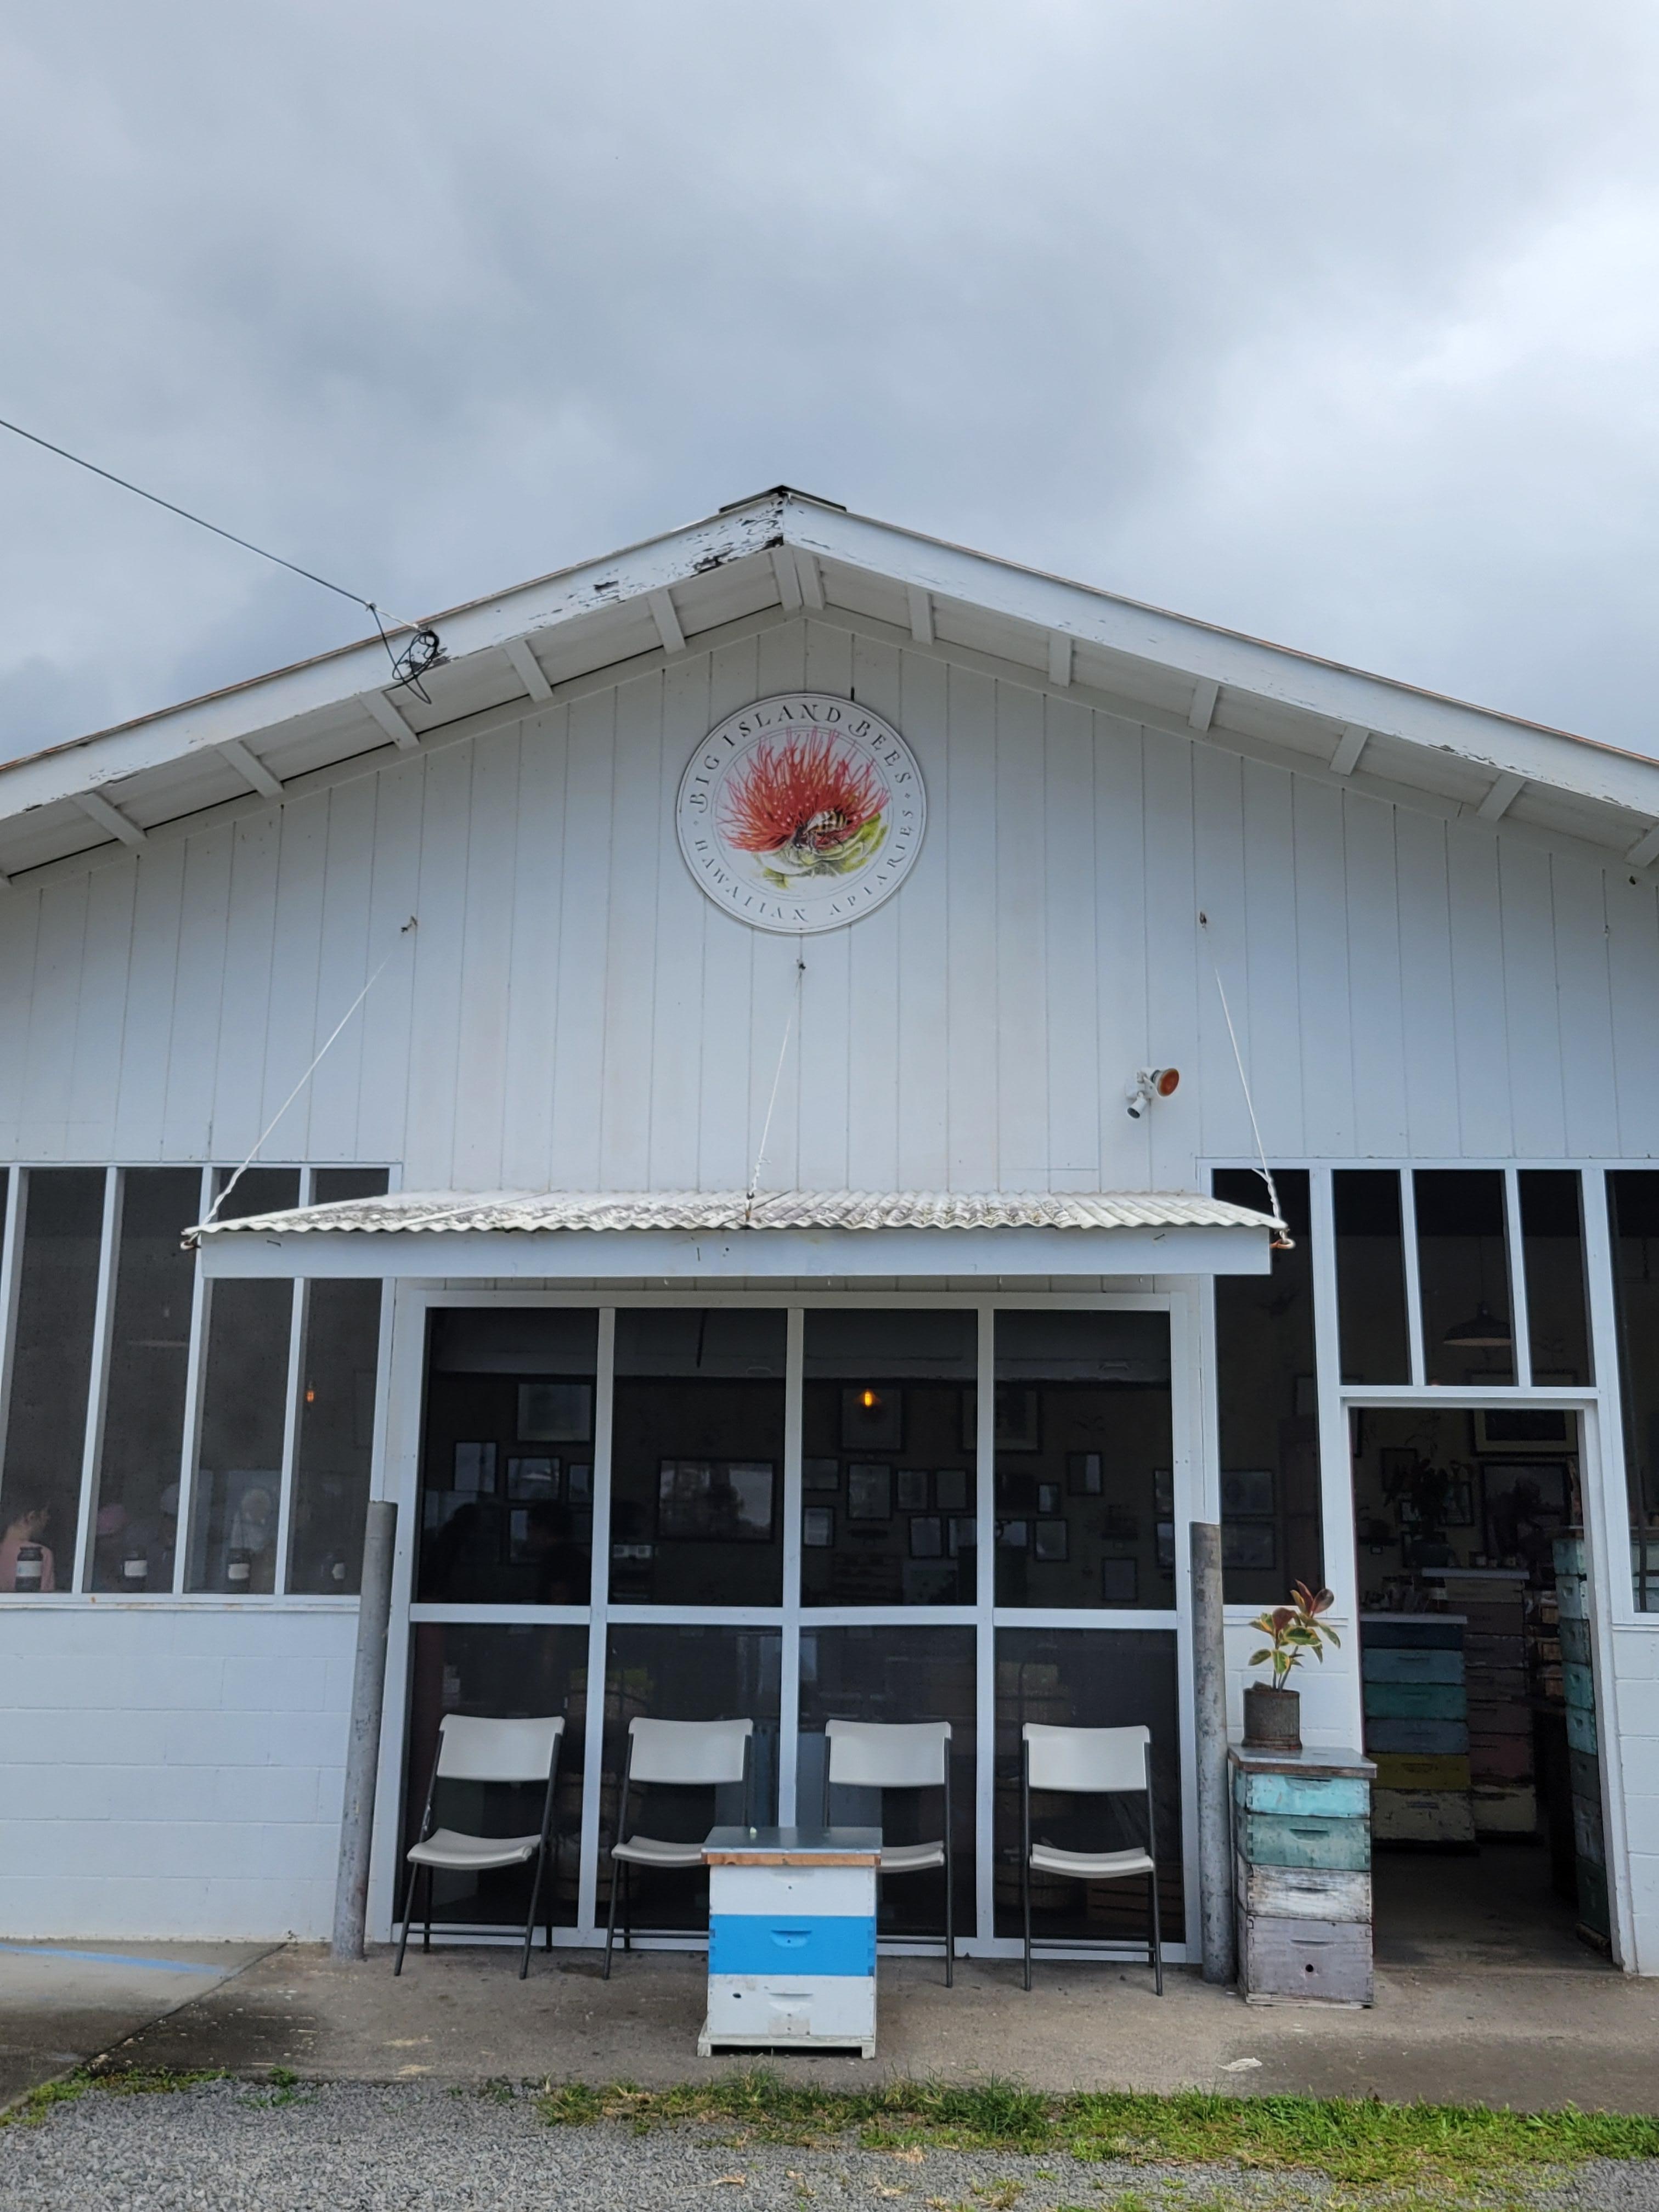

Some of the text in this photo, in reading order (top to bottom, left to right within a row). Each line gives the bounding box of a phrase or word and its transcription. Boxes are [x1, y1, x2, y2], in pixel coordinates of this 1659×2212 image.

[690, 704, 911, 813] BIG ISLAND BEES
[695, 809, 915, 922] HAWAIIAN APIARIES
